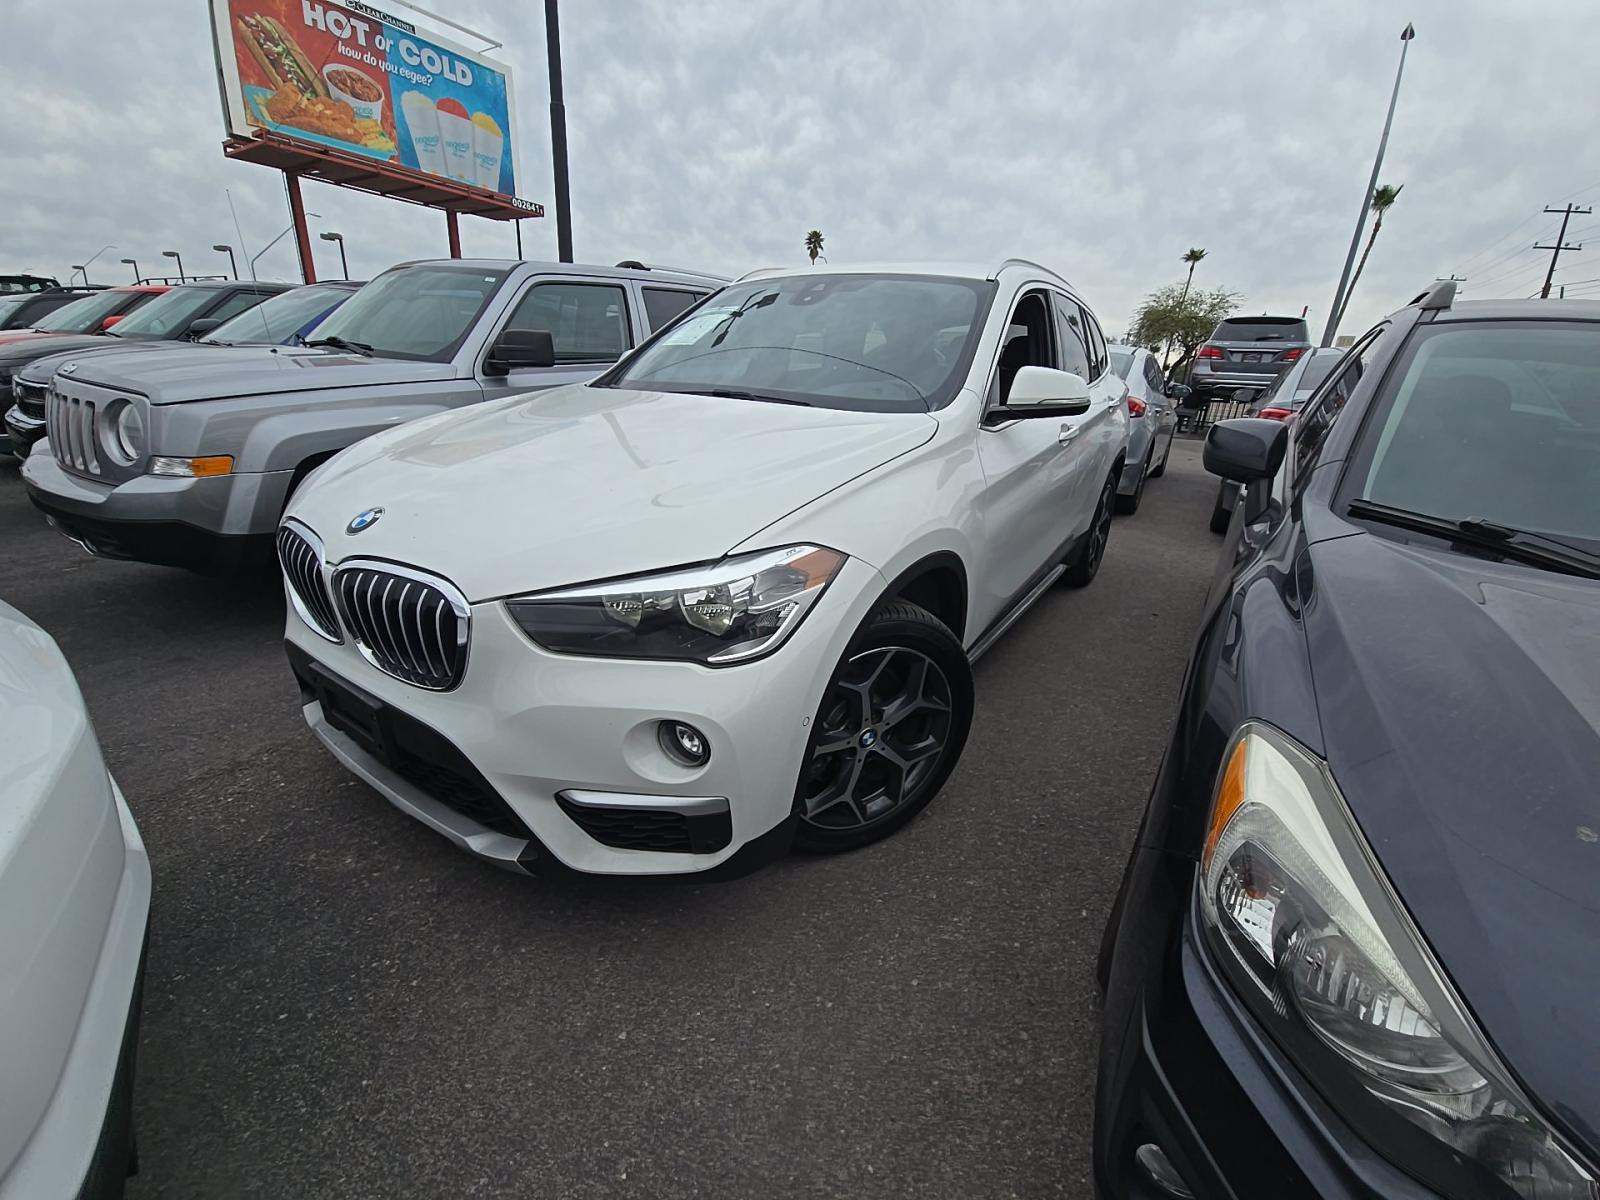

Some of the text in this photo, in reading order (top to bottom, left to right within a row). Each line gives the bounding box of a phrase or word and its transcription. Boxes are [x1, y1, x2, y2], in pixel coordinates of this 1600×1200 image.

[356, 2, 414, 33] CLEAR CHANNEL
[302, 0, 474, 87] HOT or COLD
[337, 40, 434, 87] how do you eegee?
